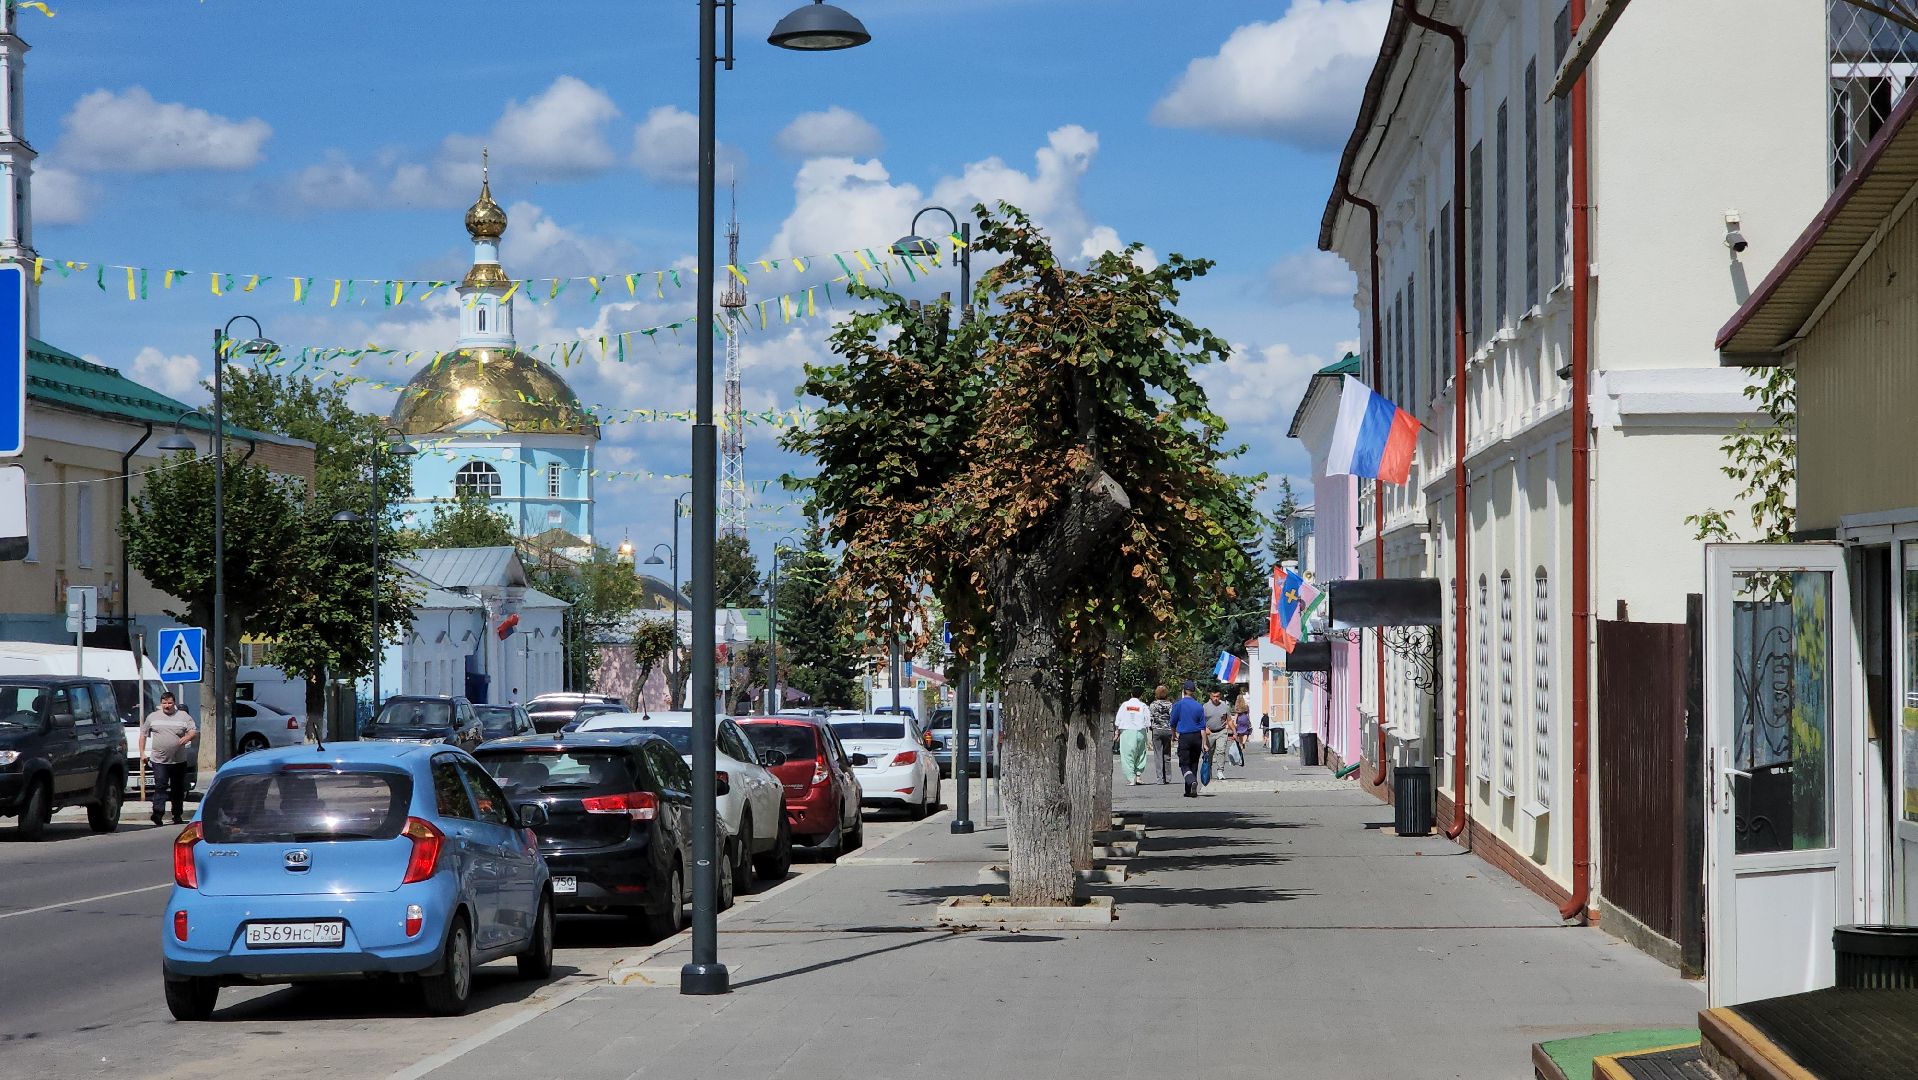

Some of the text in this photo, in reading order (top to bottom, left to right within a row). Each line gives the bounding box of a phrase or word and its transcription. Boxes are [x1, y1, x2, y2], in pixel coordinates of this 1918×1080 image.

[288, 852, 305, 862] KIA
[555, 877, 573, 887] 750
[315, 924, 338, 936] 790
